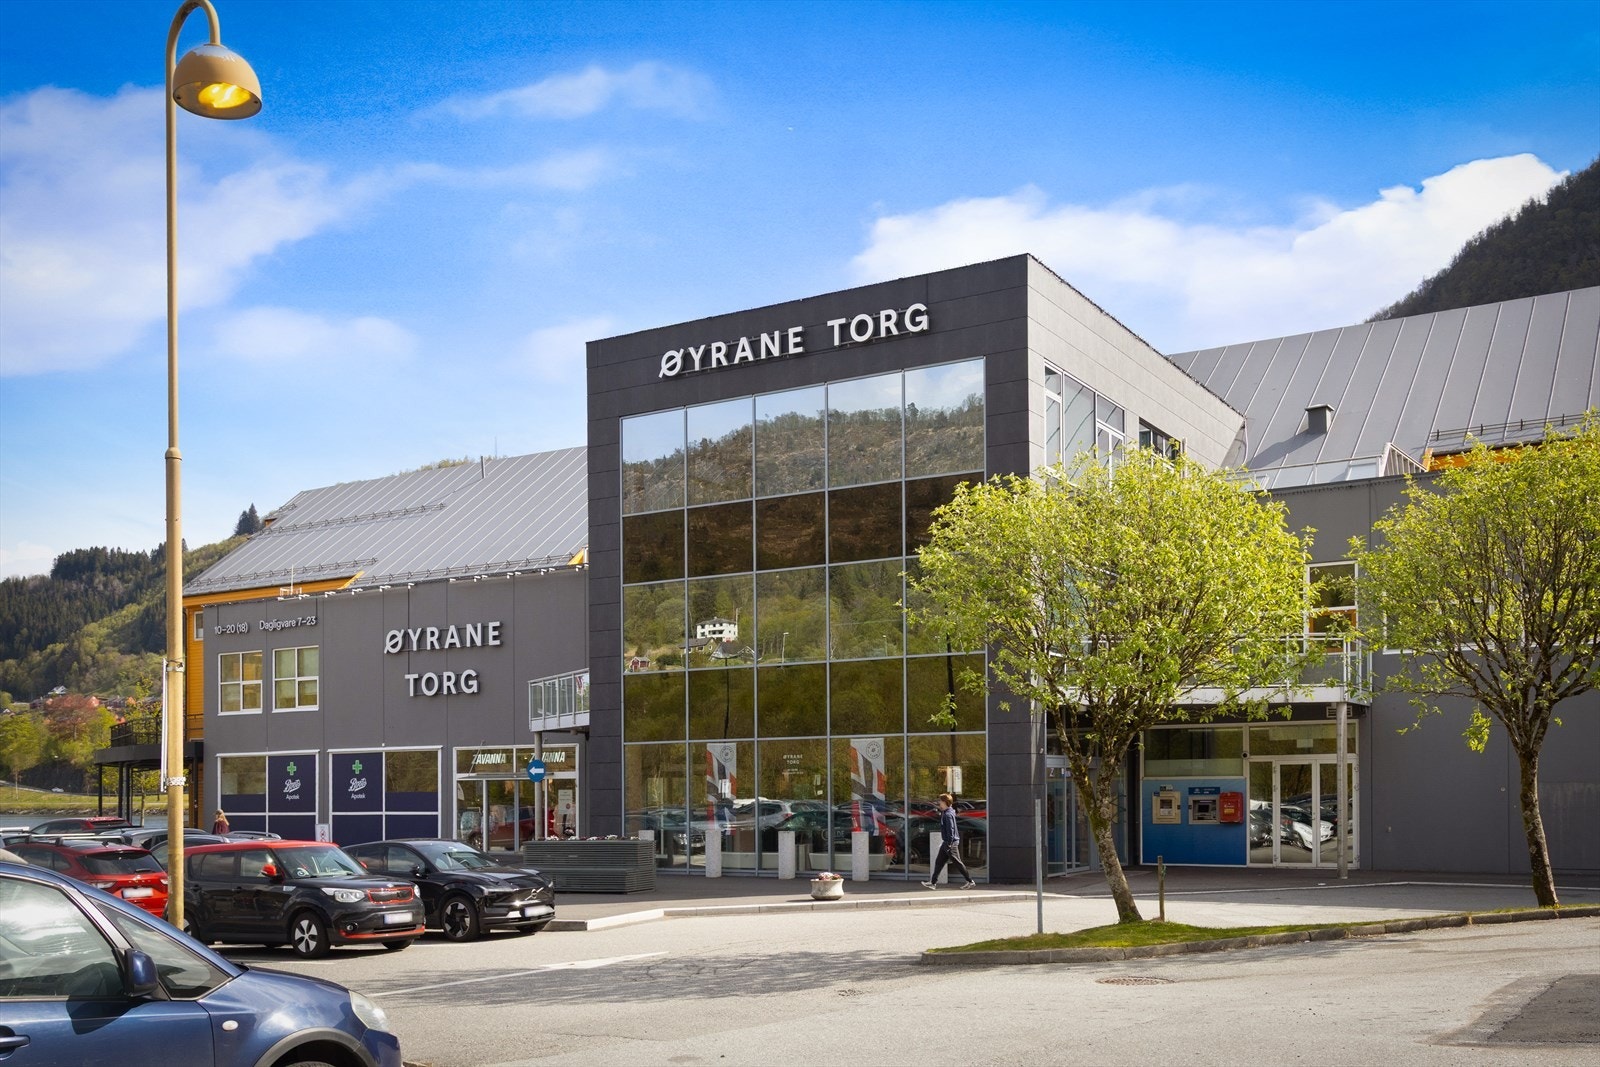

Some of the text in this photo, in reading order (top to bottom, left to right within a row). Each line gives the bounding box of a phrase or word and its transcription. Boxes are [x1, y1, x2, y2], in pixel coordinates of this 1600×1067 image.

[659, 303, 929, 378] ØYRANE TORG
[236, 622, 249, 634] (18)
[259, 619, 296, 631] Dagligvare
[384, 621, 501, 654] ØYRANE
[404, 669, 478, 697] TORG
[471, 753, 507, 765] ZAVANNA
[283, 779, 301, 793] Boots
[348, 777, 367, 792] Boots
